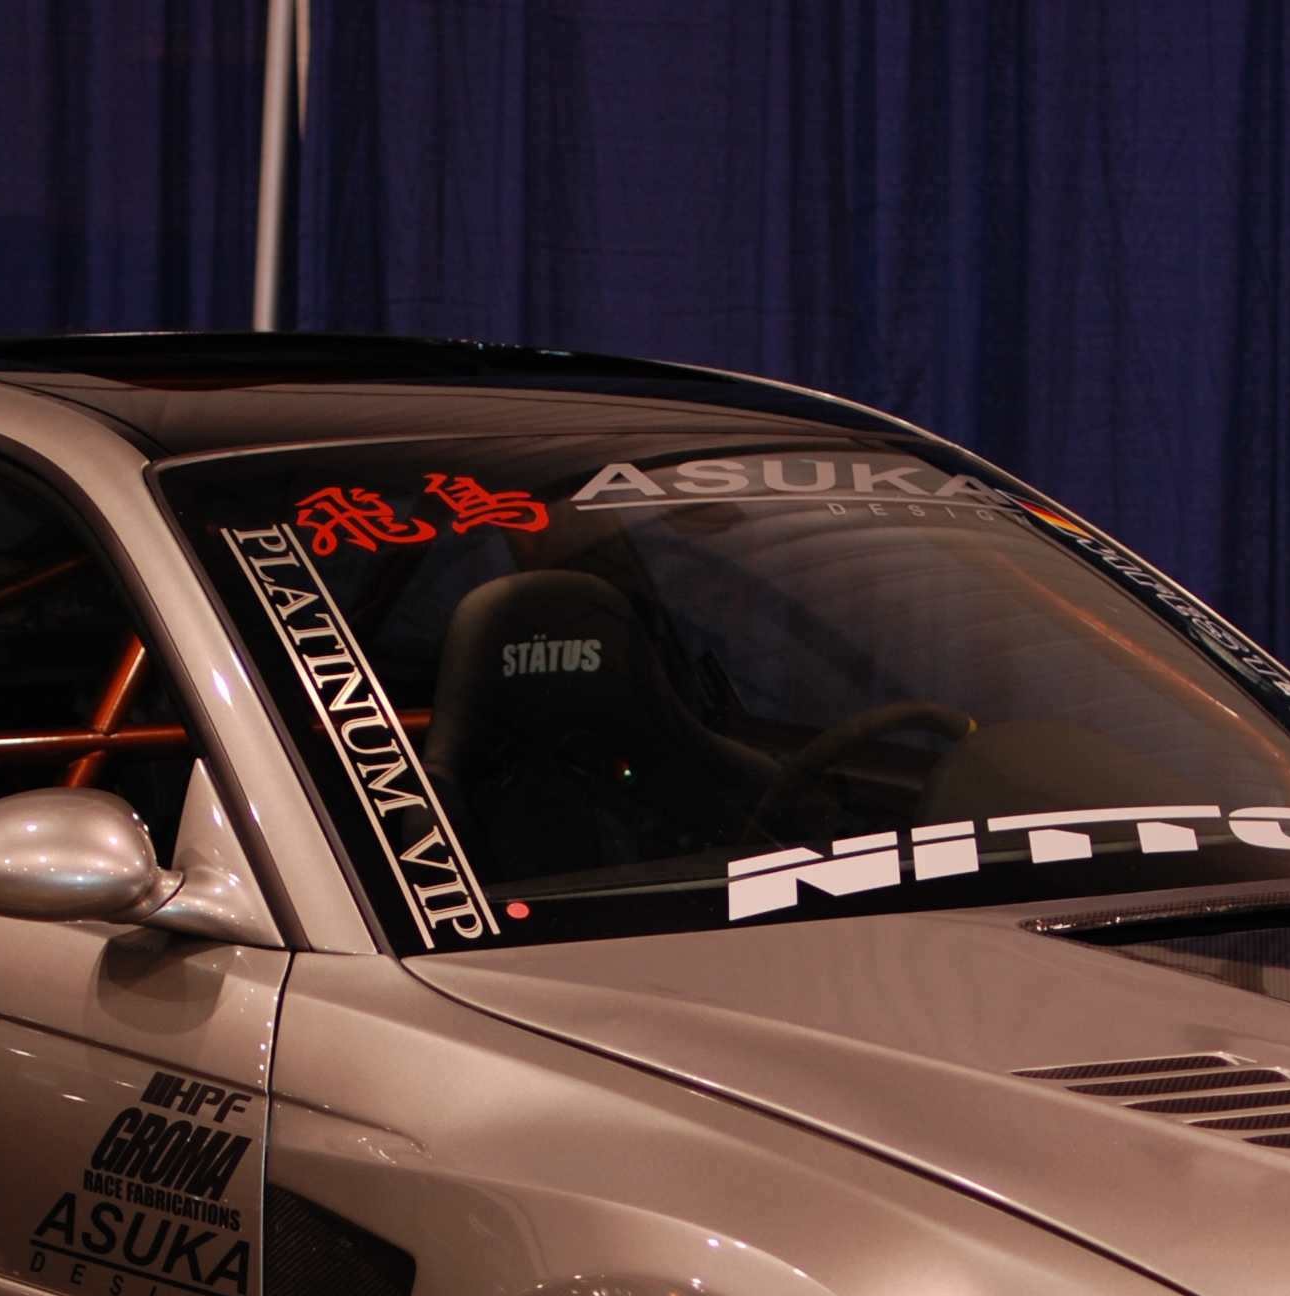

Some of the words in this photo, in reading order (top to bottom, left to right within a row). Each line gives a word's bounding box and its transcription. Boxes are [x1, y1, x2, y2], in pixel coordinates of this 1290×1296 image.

[569, 459, 1013, 506] ASUKA
[231, 523, 429, 819] PLATINUM
[398, 825, 485, 940] VIP
[84, 1168, 123, 1200] RACE
[126, 1180, 241, 1232] FABRICATIONS
[33, 1192, 251, 1296] ASUKA
